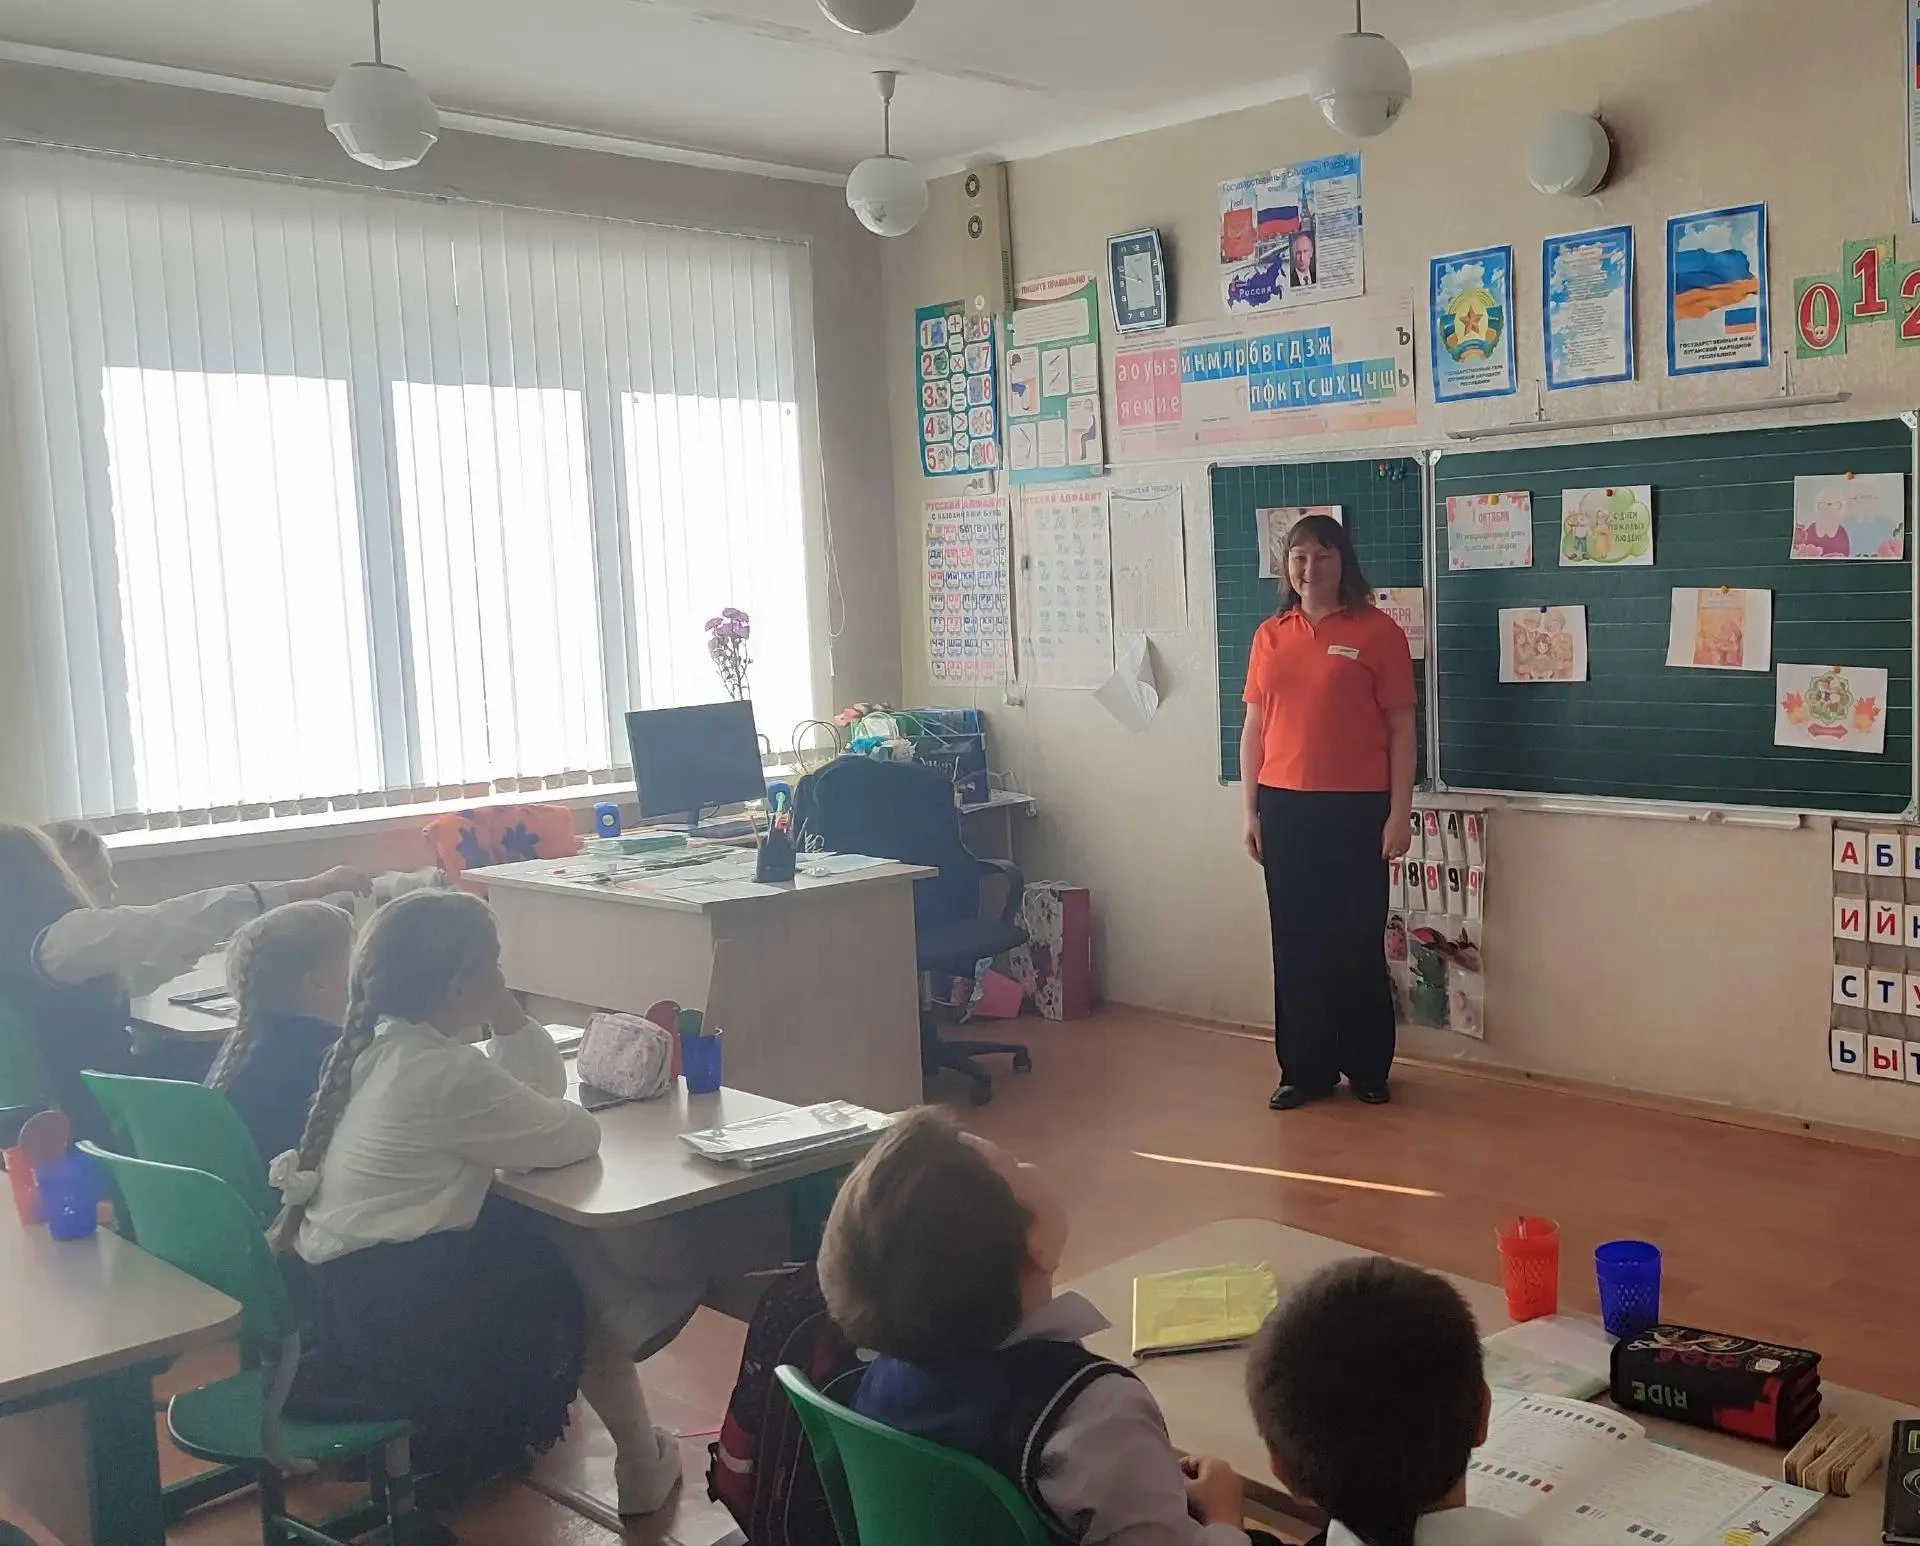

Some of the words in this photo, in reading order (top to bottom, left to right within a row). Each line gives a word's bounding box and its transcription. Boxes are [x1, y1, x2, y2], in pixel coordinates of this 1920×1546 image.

[1851, 247, 1888, 317] 1
[1900, 268, 1920, 340] 2
[1797, 283, 1842, 350] 0
[1680, 337, 1738, 348] ГОСУДАРСТВЕННЫЙ
[1683, 346, 1717, 355] ЛУГАНСКОЙ
[1719, 343, 1751, 351] НАРОДНОЙ
[923, 354, 934, 377] 2
[982, 345, 991, 369] 7
[1698, 351, 1736, 360] РЕСПУБЛИКИ
[924, 385, 934, 408] 3
[983, 377, 991, 401] 8
[925, 416, 936, 439] 4
[984, 408, 993, 432] 9
[927, 447, 937, 470] 5
[980, 440, 996, 464] 10
[1410, 811, 1421, 837] 3
[1425, 811, 1438, 837] 3
[1448, 813, 1459, 839] 4
[1467, 816, 1478, 842] 4
[1840, 841, 1859, 865] А
[1876, 844, 1893, 867] Б
[1389, 862, 1401, 886] 7
[1408, 862, 1420, 887] 8
[1426, 865, 1438, 891] 8
[1448, 867, 1460, 893] 9
[1840, 908, 1859, 932] И
[1876, 905, 1896, 936] Й
[1841, 975, 1858, 998] С
[1877, 979, 1895, 1004] Т
[1631, 1380, 1689, 1410] RIDE
